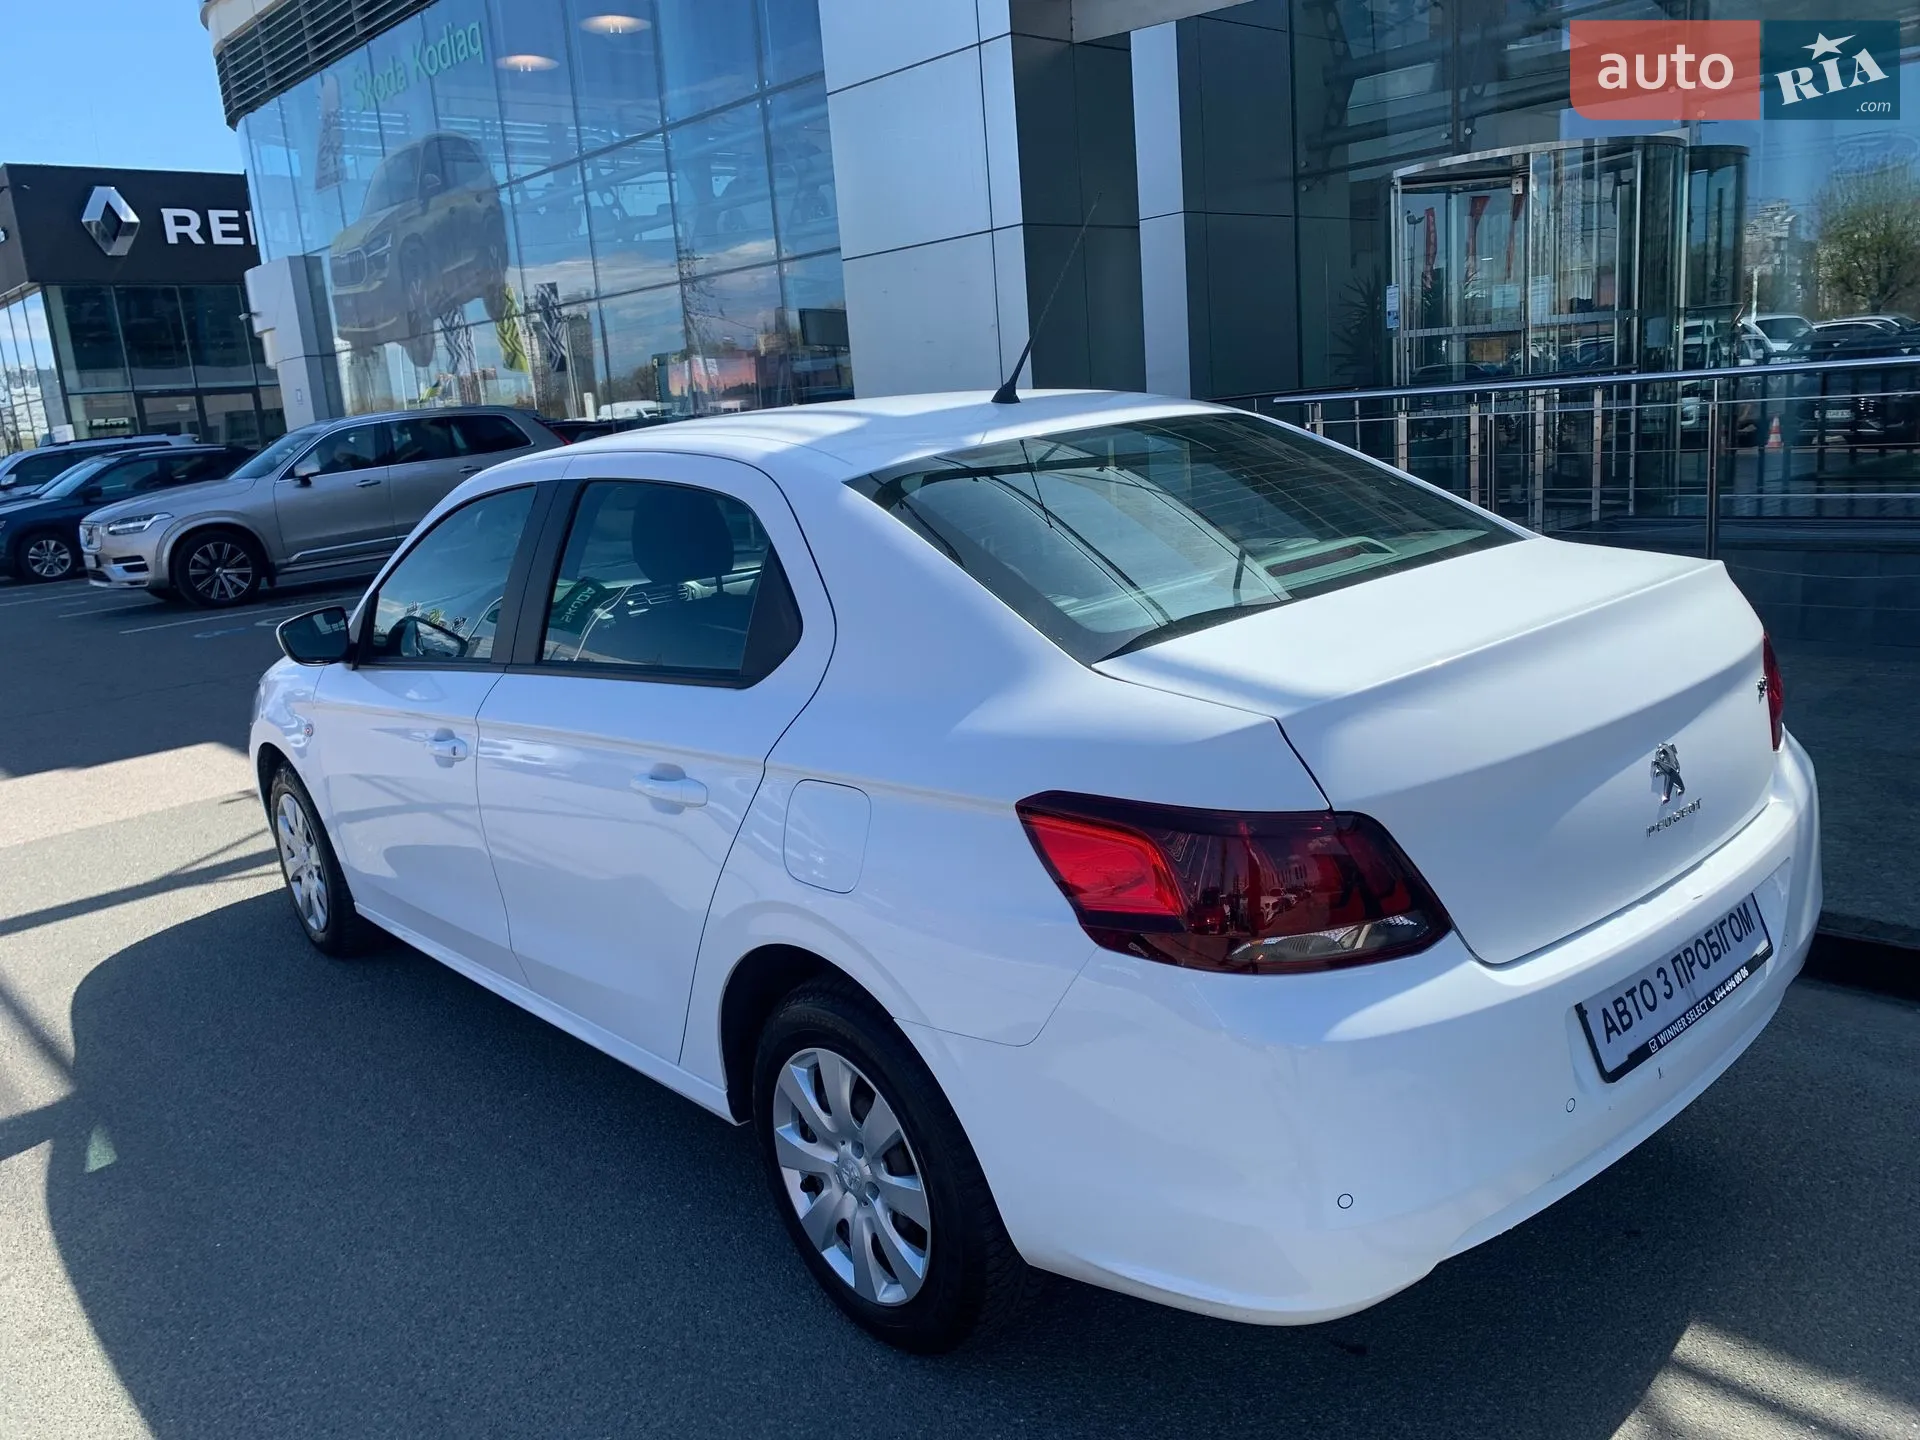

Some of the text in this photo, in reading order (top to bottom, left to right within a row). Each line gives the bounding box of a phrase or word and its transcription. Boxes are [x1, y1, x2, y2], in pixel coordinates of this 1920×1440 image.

[412, 21, 484, 82] Kodiaq
[160, 208, 257, 246] RE
[1646, 798, 1702, 838] PEUGEOT
[1601, 978, 1658, 1044] АВТО
[1671, 902, 1755, 989] ПРОБІГОМ
[1657, 1017, 1688, 1046] WINNER
[1685, 999, 1710, 1025] SELECT
